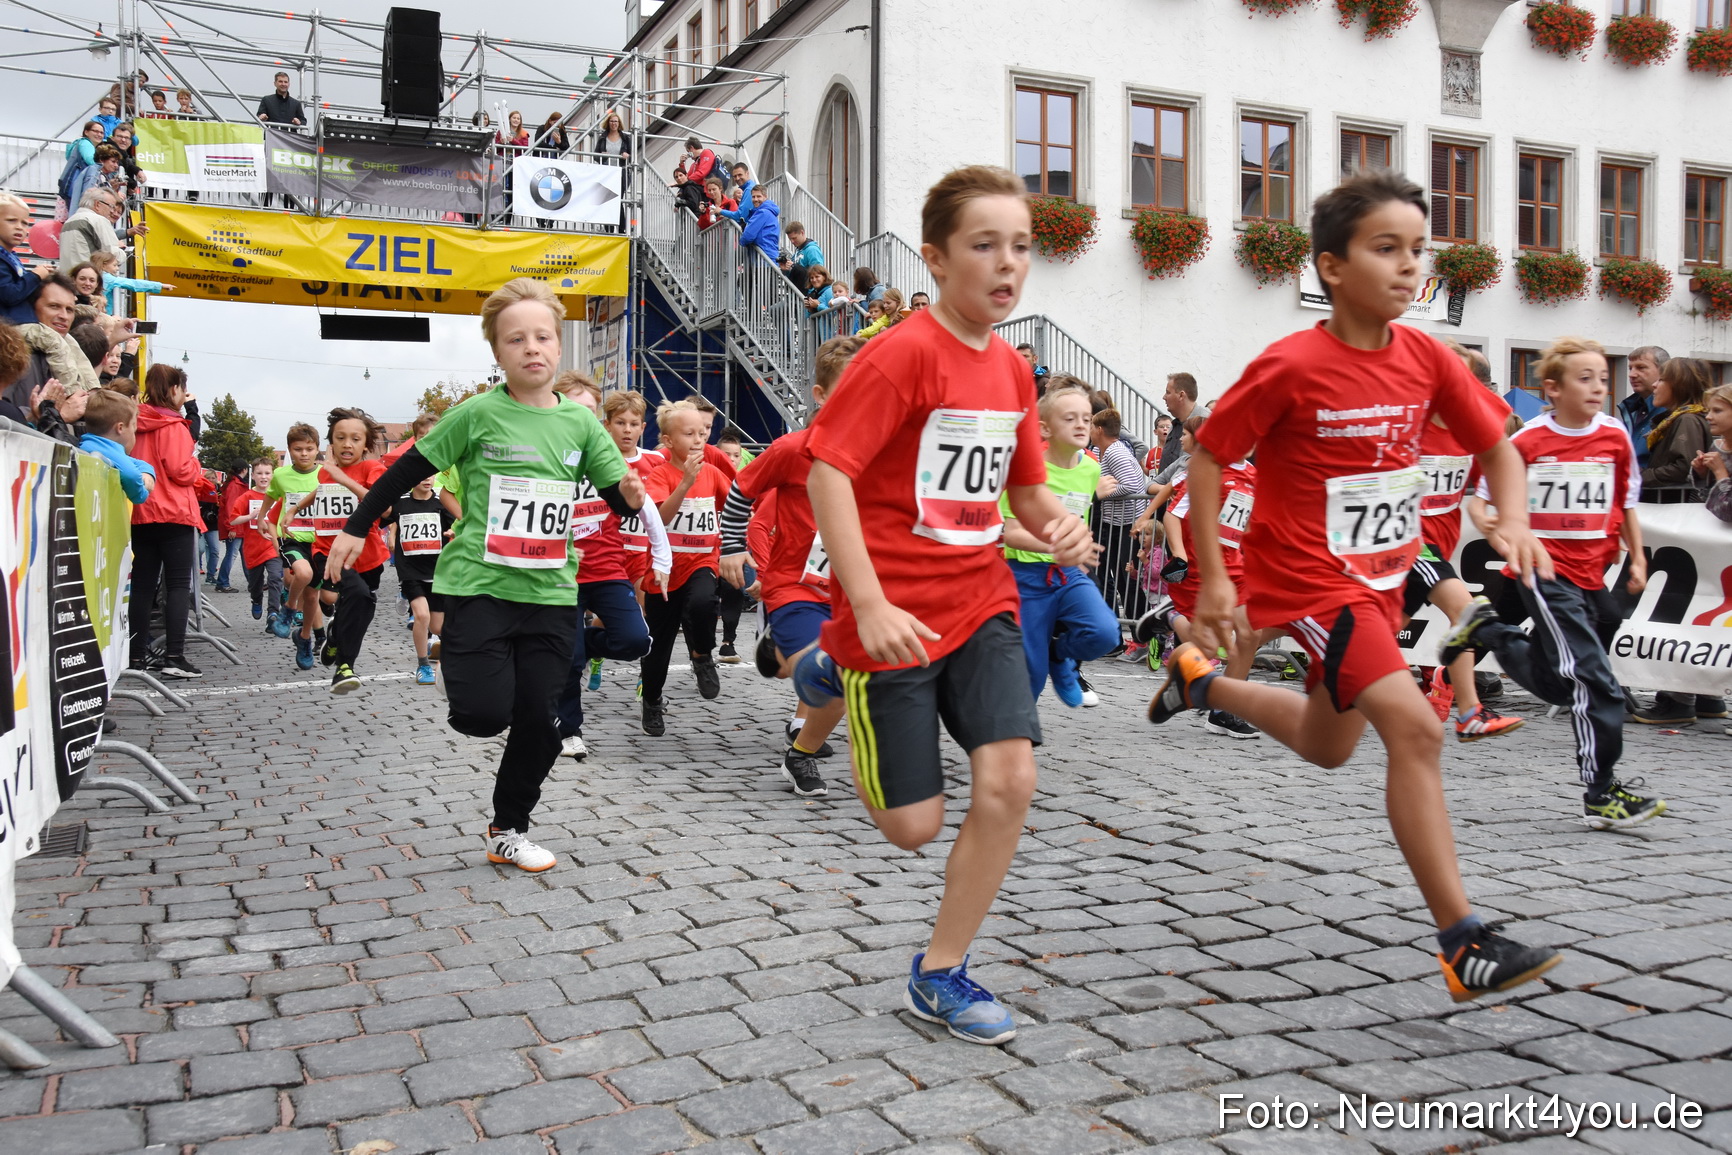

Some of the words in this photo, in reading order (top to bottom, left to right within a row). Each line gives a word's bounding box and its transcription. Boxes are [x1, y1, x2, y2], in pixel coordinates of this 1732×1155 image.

[271, 147, 356, 174] BOCK
[362, 161, 399, 173] OFFICE
[401, 165, 454, 178] INDUSTRY
[203, 167, 257, 178] NeuerMarkt
[534, 167, 570, 185] BMW
[382, 177, 479, 195] www.bockonline.de
[172, 237, 233, 253] Neumarkter
[236, 246, 284, 258] Stadtlauf
[345, 232, 453, 276] ZIEL
[173, 270, 229, 282] Neumarkter
[230, 274, 274, 286] Stadtlauf
[510, 264, 562, 275] Neumarkter
[564, 267, 606, 276] Stadtlauf
[1316, 404, 1405, 422] Neumarkter
[1316, 422, 1390, 439] Stadtlauf
[1538, 481, 1607, 509] 7144
[315, 496, 354, 516] 7155
[321, 520, 342, 529] David
[500, 498, 570, 535] 7169
[672, 511, 715, 532] 7146
[1560, 517, 1586, 528] Luis
[403, 523, 438, 540] 7243
[520, 542, 547, 556] Luca
[682, 536, 705, 546] Kilian
[1615, 634, 1732, 668] eumar
[60, 652, 87, 669] Freizeit
[62, 696, 103, 717] Stadtbusse
